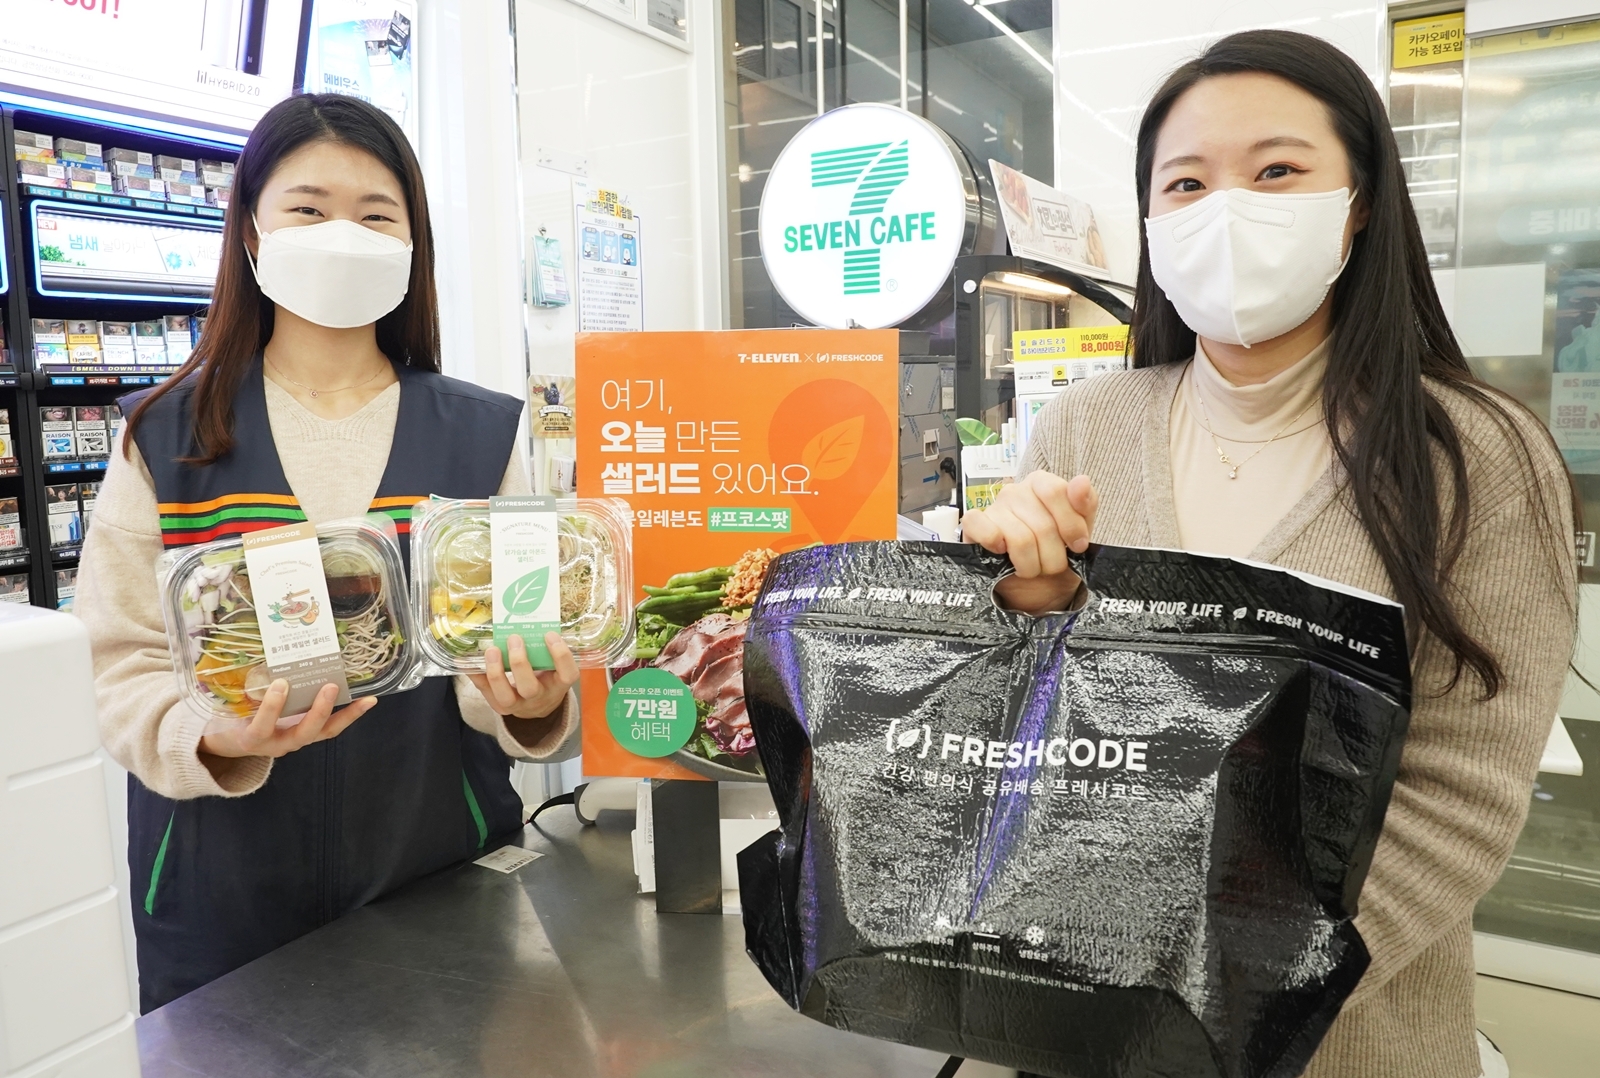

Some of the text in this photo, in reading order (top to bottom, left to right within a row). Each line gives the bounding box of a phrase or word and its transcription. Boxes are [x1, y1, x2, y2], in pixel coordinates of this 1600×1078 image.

[1408, 28, 1461, 45] 카카오페이
[1408, 46, 1429, 57] 가능
[208, 76, 246, 93] HYBRID
[247, 85, 261, 97] 2.0
[323, 72, 360, 91] 메비우스
[38, 219, 56, 231] NEW
[784, 210, 936, 253] SEVEN CAFE
[68, 233, 99, 252] 냄새
[1080, 333, 1109, 341] 110,000원
[1081, 340, 1125, 353] 88,000원
[737, 352, 884, 363] 7-ELEVEN FRESHCODE
[600, 378, 673, 414] 여기,
[600, 420, 742, 454] 오늘 만든
[600, 462, 820, 496] 샐러드 있어요.
[501, 522, 549, 533] SIGNATURE MENU
[710, 510, 789, 530] #프코스팟
[256, 530, 301, 544] FRESHCODE
[763, 586, 1382, 659] FRESH YOUR LIFE FRESH YOUR LIFE FRESH YOUR LIFE FRESH YOUR LIFE
[272, 664, 292, 674] Medium
[618, 687, 646, 696] 프코스팟
[662, 688, 684, 697] 이벤트
[623, 699, 678, 720] 7만원
[630, 721, 671, 742] 혜택
[941, 733, 1149, 771] FRESHCODE
[882, 762, 1148, 800] 건강 편의식 공유배송 프레시코드
